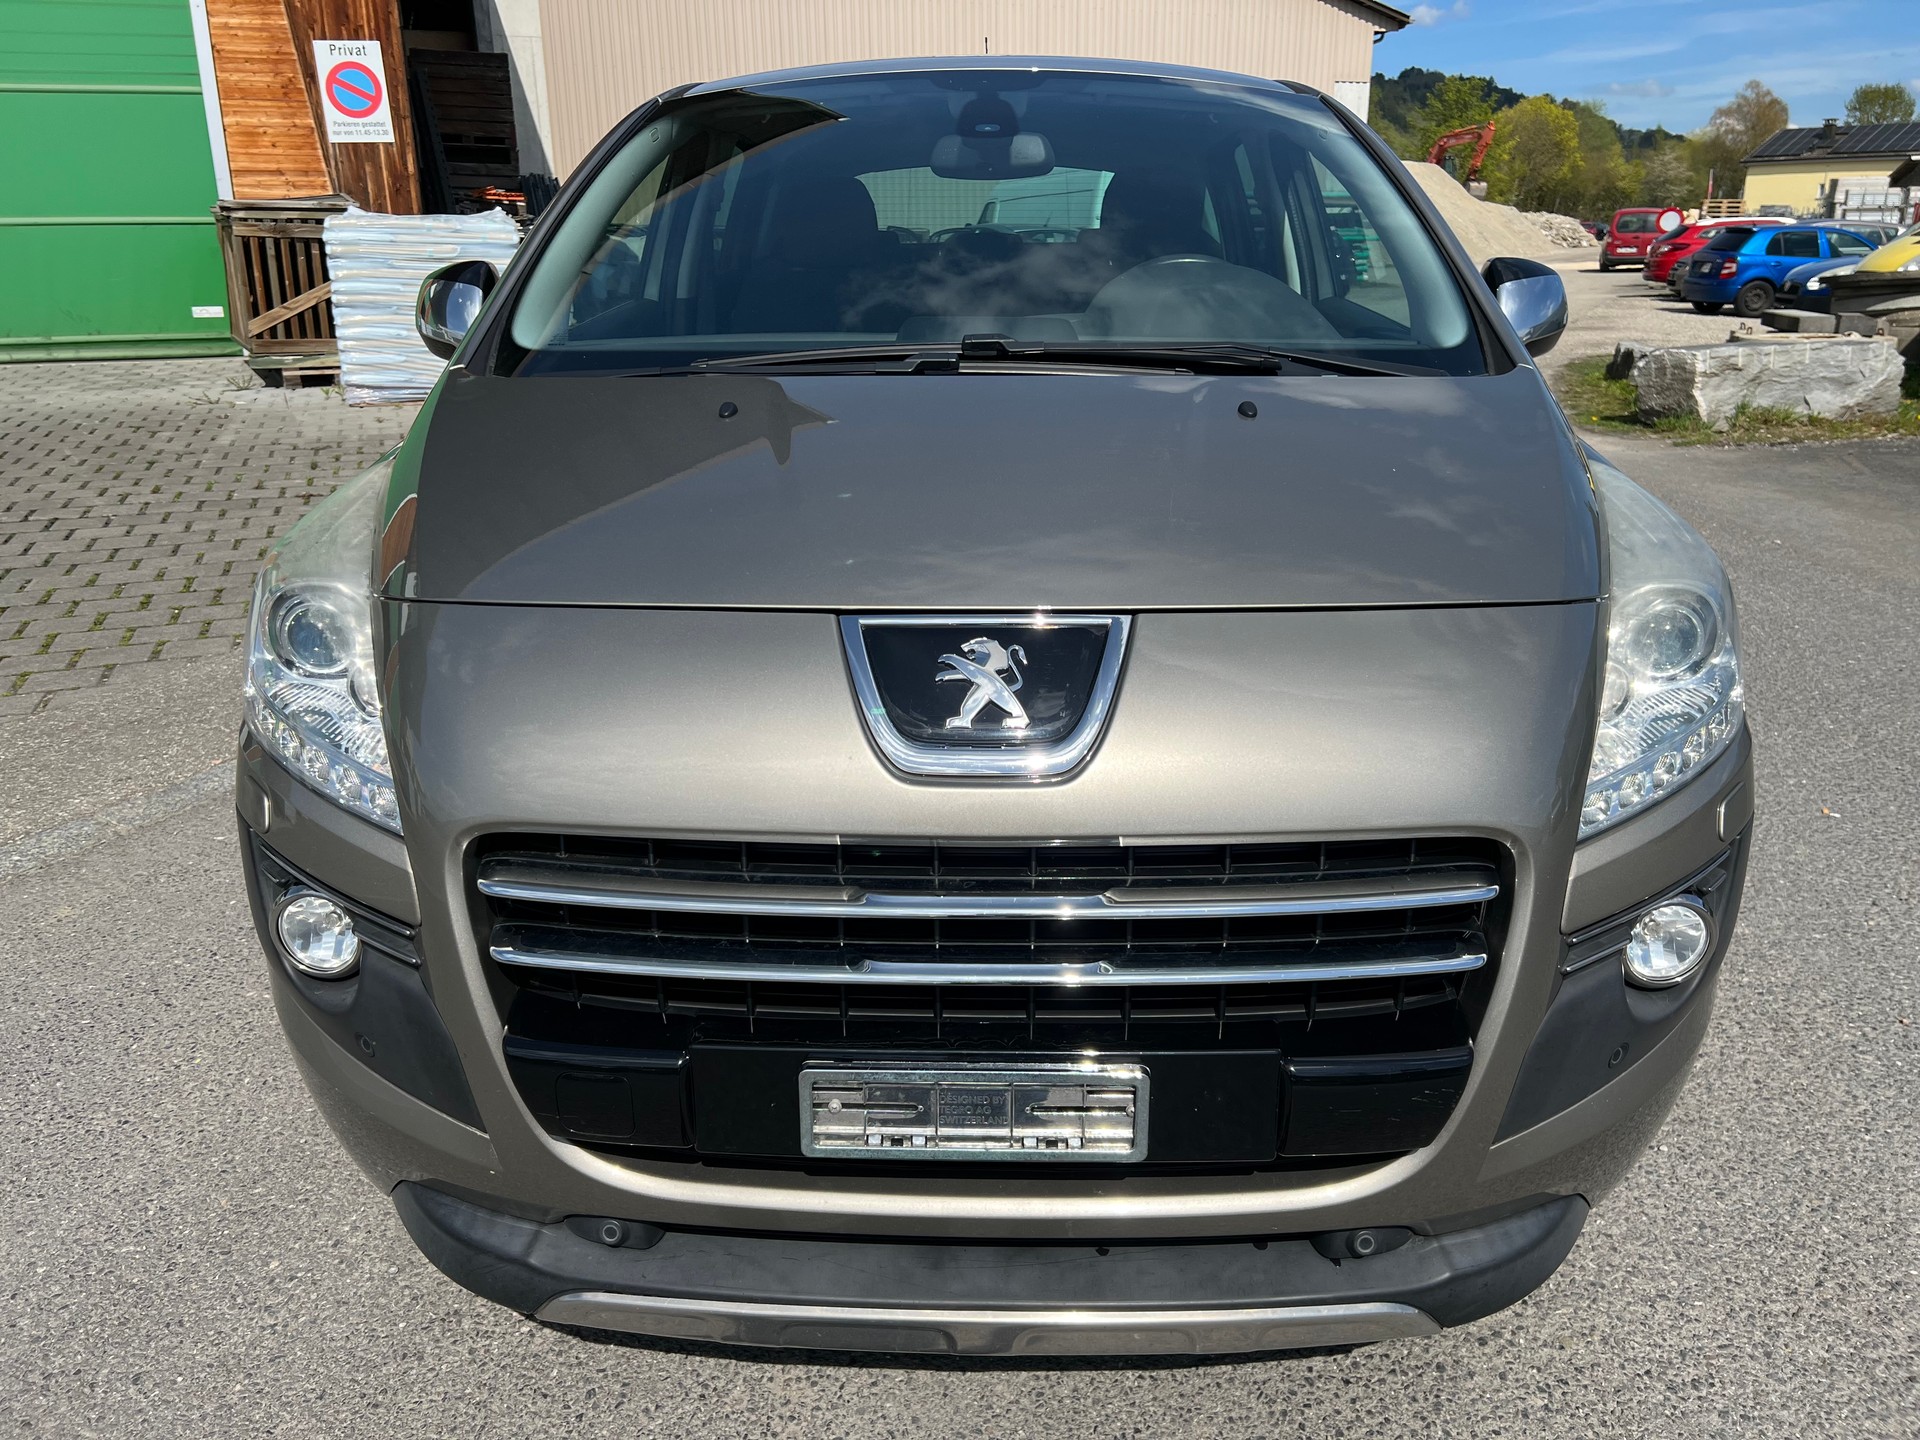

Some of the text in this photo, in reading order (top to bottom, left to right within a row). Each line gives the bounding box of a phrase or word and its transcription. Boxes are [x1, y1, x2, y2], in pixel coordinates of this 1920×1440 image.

[329, 44, 367, 56] Privat
[940, 1095, 1005, 1104] DESIGNED BY
[940, 1105, 992, 1114] TEGRO AG
[940, 1115, 1009, 1124] SWITZERLAND
